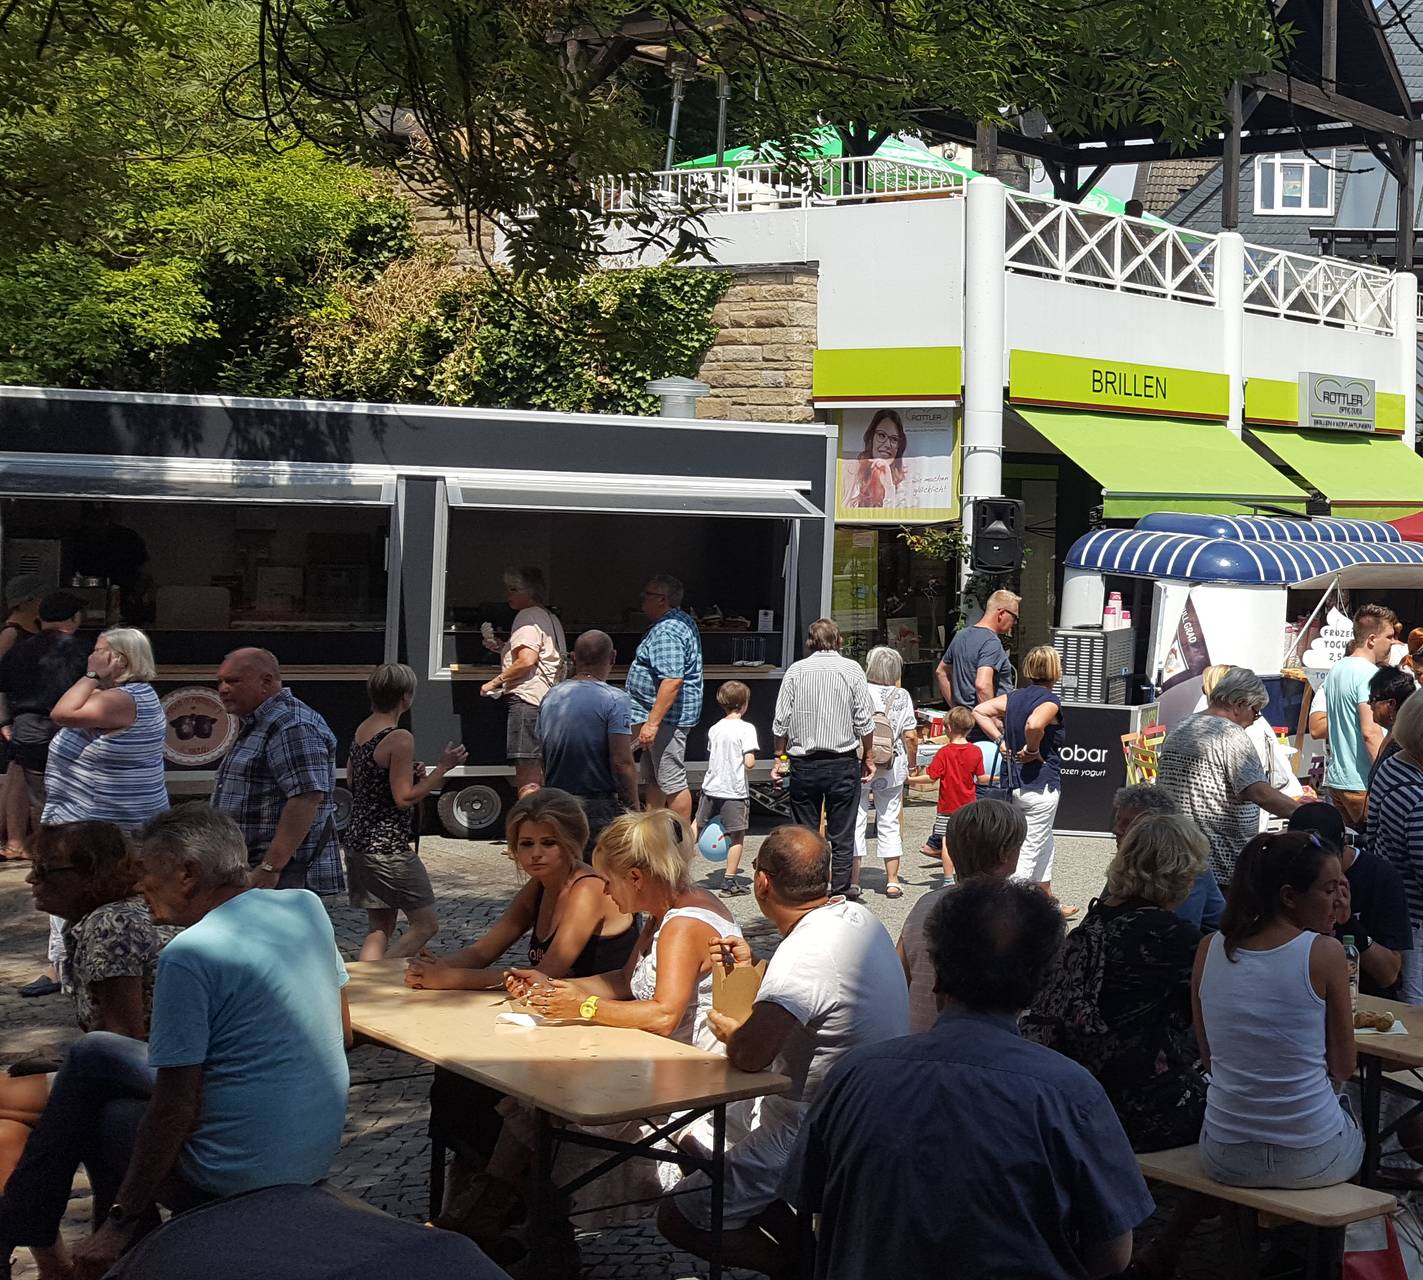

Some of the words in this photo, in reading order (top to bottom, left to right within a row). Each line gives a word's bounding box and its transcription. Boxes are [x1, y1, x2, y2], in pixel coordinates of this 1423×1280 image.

[1092, 369, 1167, 399] BRILLEN
[1323, 641, 1348, 649] YOGU
[1329, 652, 1344, 662] 2,5
[1315, 671, 1329, 680] TO
[1060, 767, 1080, 776] ozen
[1080, 769, 1106, 778] yogurt
